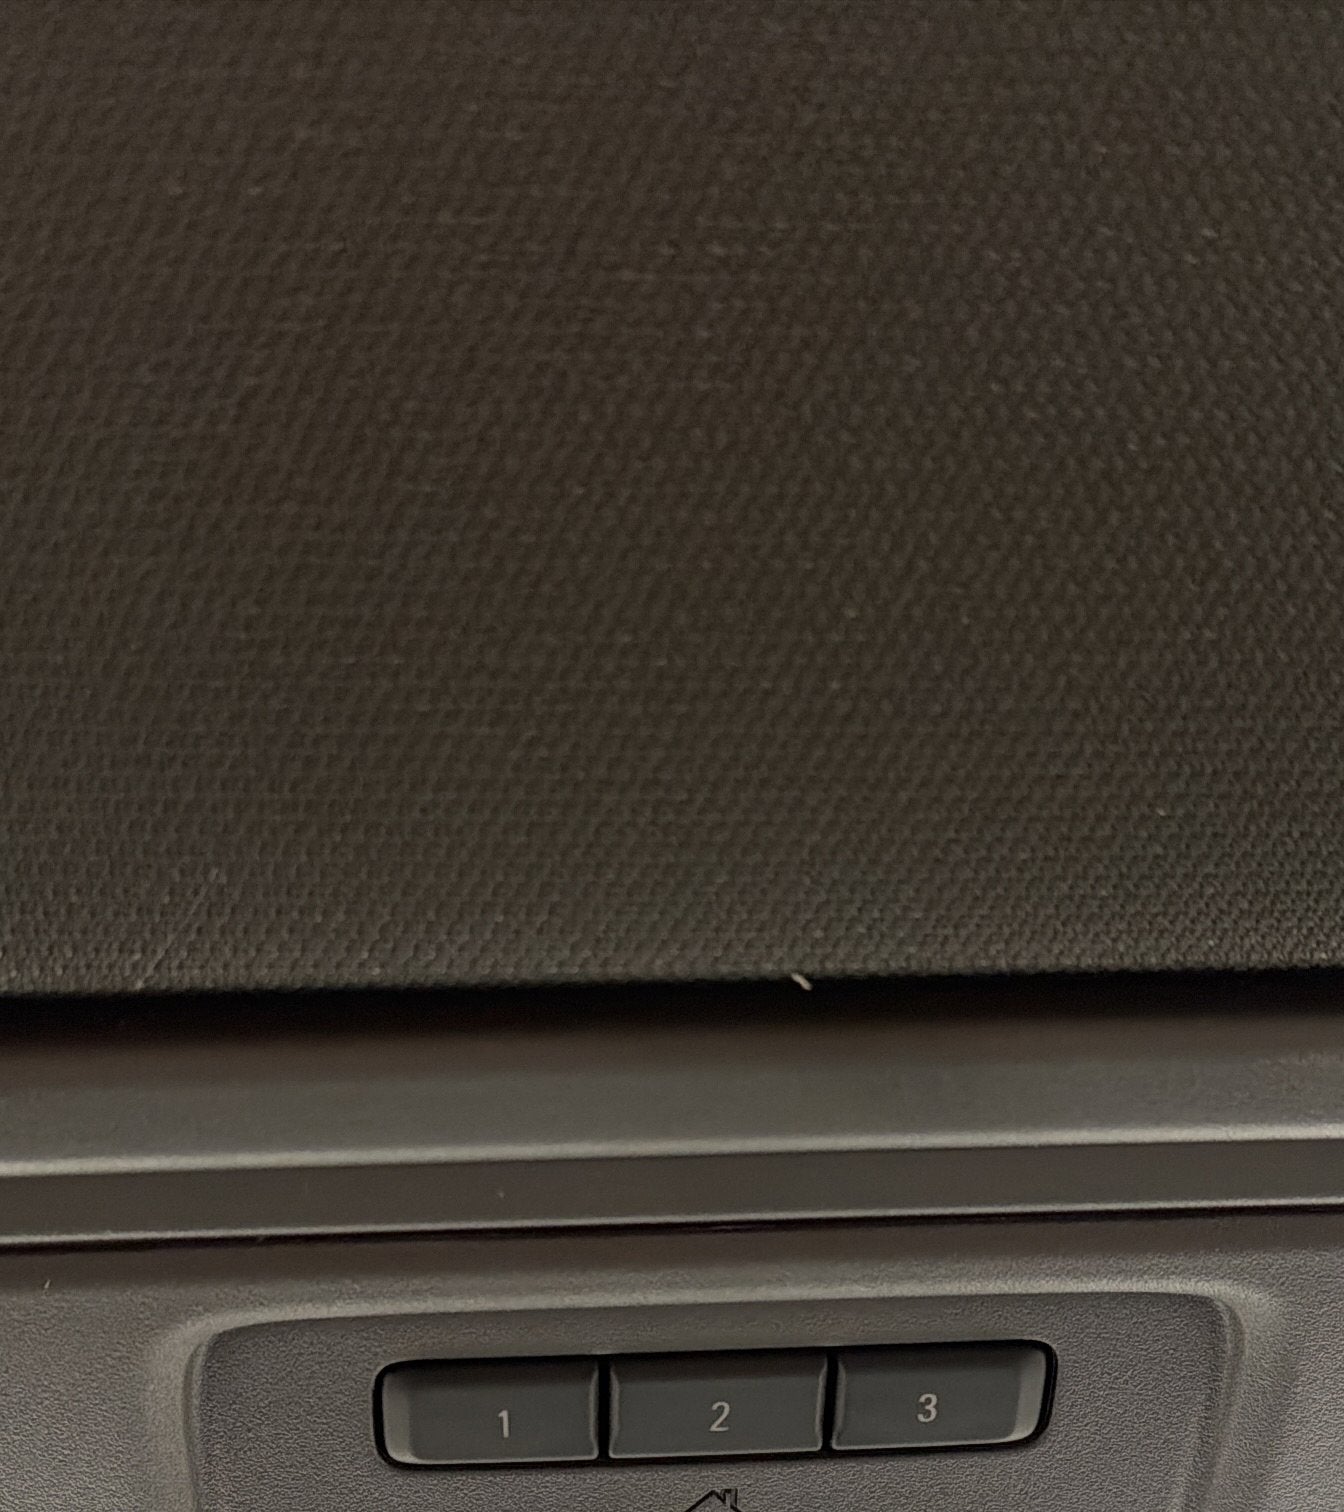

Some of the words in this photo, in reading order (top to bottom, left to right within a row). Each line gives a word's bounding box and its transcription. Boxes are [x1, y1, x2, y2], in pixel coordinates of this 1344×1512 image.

[496, 1408, 513, 1439] 1
[709, 1401, 731, 1433] 2
[917, 1392, 939, 1424] 3
